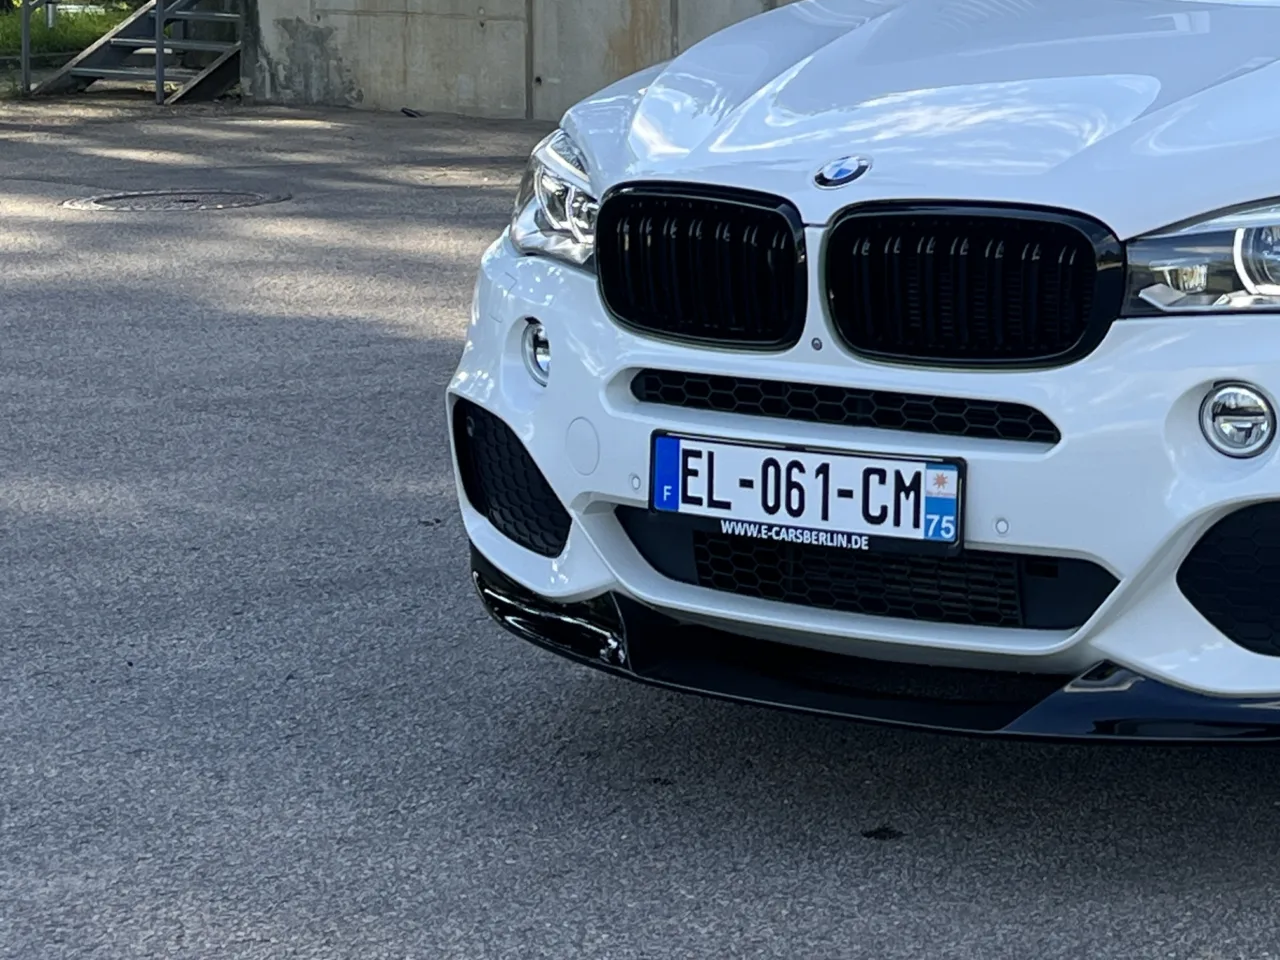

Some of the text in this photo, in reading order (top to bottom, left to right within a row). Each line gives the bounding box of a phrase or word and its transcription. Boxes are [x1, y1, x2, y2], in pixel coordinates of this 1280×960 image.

[663, 485, 672, 501] F
[681, 448, 922, 529] EL-061-CM
[721, 520, 869, 550] WWW.E-CARSBERLIN.DE
[926, 514, 955, 539] 75
